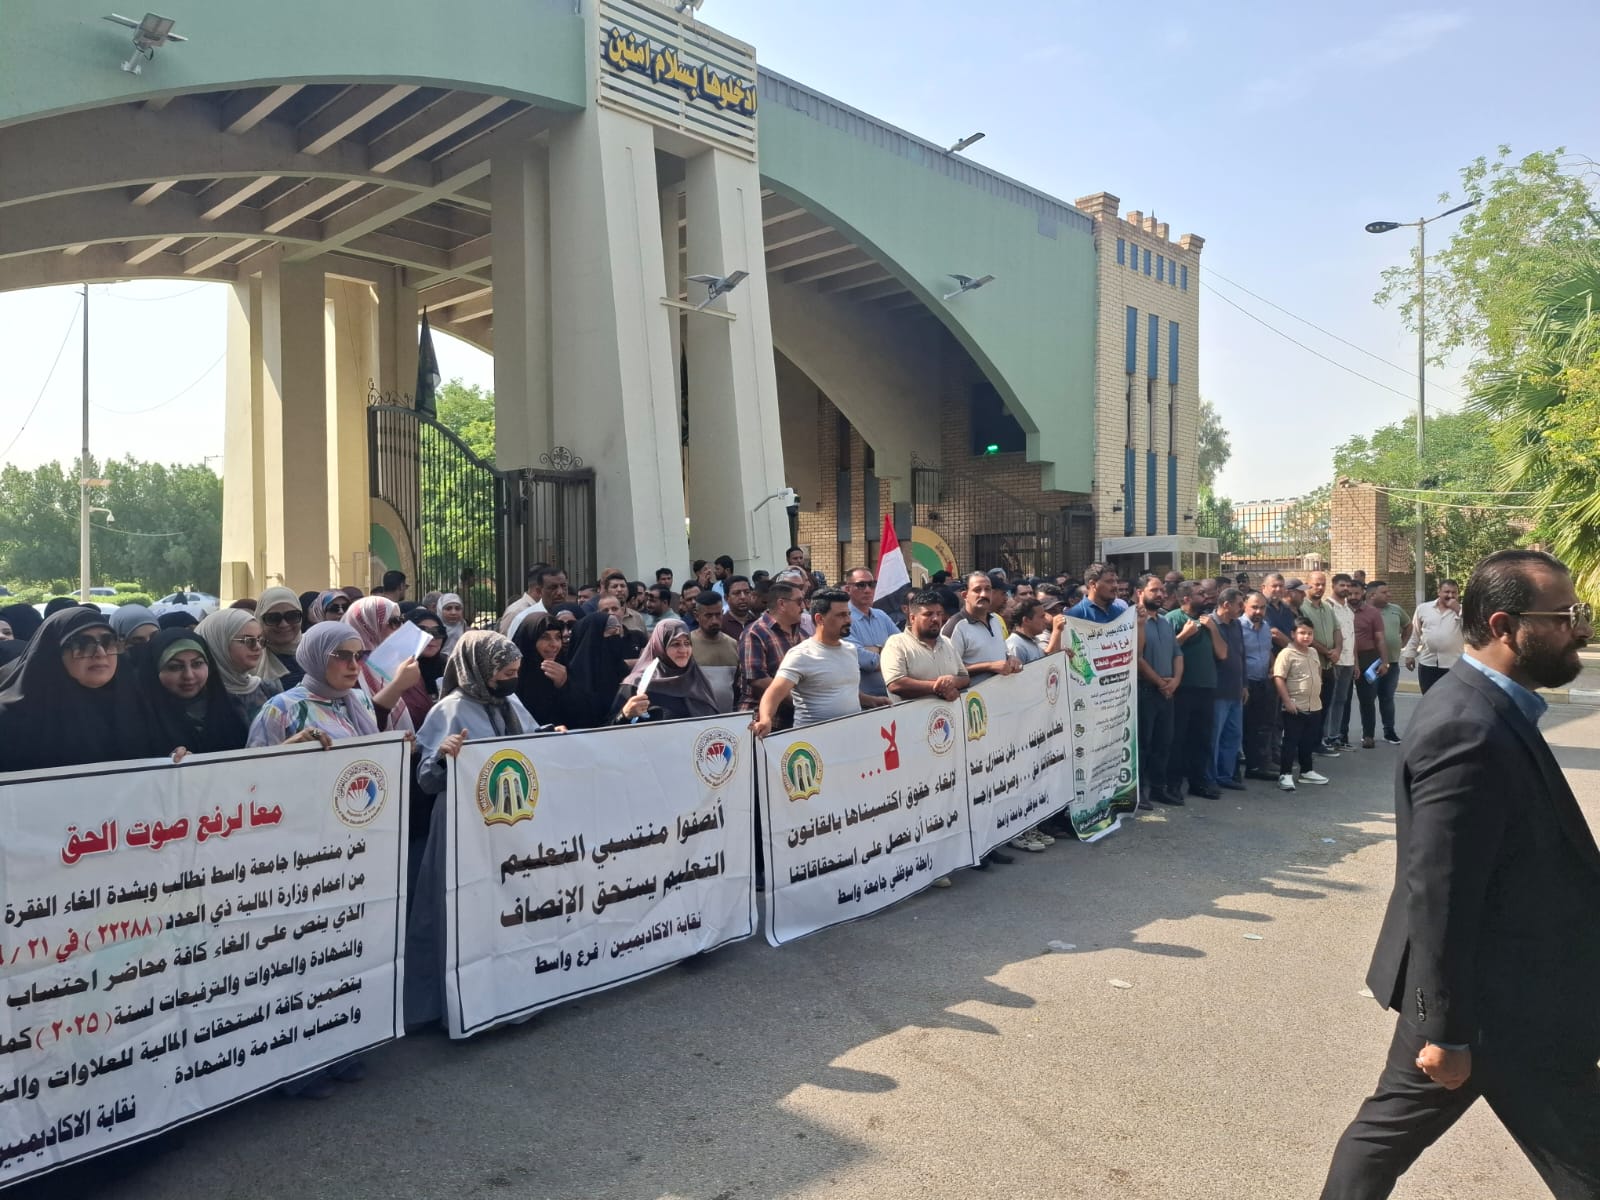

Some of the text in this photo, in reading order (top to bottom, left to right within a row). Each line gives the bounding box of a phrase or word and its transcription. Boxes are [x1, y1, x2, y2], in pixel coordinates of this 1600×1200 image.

[655, 47, 698, 98] بسلام
[845, 789, 902, 827] اكتسبناها
[906, 780, 930, 810] حقوق
[125, 816, 191, 850] صوت
[196, 803, 243, 842] لرفع
[788, 813, 842, 849] بالقانون
[61, 818, 118, 865] الحق
[500, 797, 725, 884] أنصفوا منتسبي التعليم
[789, 809, 959, 885] من حقنا أن نحصل على استحقاقاتنا
[210, 862, 246, 884] واسط
[250, 854, 288, 876] جامعة
[293, 844, 343, 871] منتسبوا
[106, 880, 158, 904] وبشدة
[162, 866, 206, 898] نطالب
[311, 873, 345, 902] اعمام
[348, 872, 366, 891] من
[500, 850, 726, 928] التعليم يستحق الإنصاف
[837, 851, 933, 905] رابطة موظفي جامعة واسط
[4, 895, 57, 928] الفقرة
[63, 887, 101, 915] الغاء
[236, 888, 274, 916] المالية
[277, 883, 309, 907] وزارة
[165, 904, 206, 930] العدد
[210, 898, 232, 928] ذي
[676, 911, 702, 938] نقابة
[55, 928, 79, 964] في
[310, 938, 363, 968] والشهادة
[576, 942, 599, 968] فرع
[610, 920, 673, 959] الاكاديميين
[7, 902, 365, 1011] الذي ينص على الغاء كافة محاضر احتساب
[244, 955, 307, 986] والعلاوات
[534, 951, 572, 975] واسط
[159, 972, 240, 1012] والترفيعات
[275, 991, 304, 1015] كافة
[307, 975, 362, 1010] بتضمين
[114, 996, 154, 1025] لسنة
[193, 1001, 270, 1043] المستحقات
[302, 1005, 361, 1041] واحتساب
[140, 1028, 187, 1063] المالية
[250, 1025, 298, 1057] الخدمة
[48, 1045, 134, 1089] للعلاوات
[174, 1048, 246, 1084] والشهادة
[0, 1094, 136, 1170] نقابة الاكاديميي
